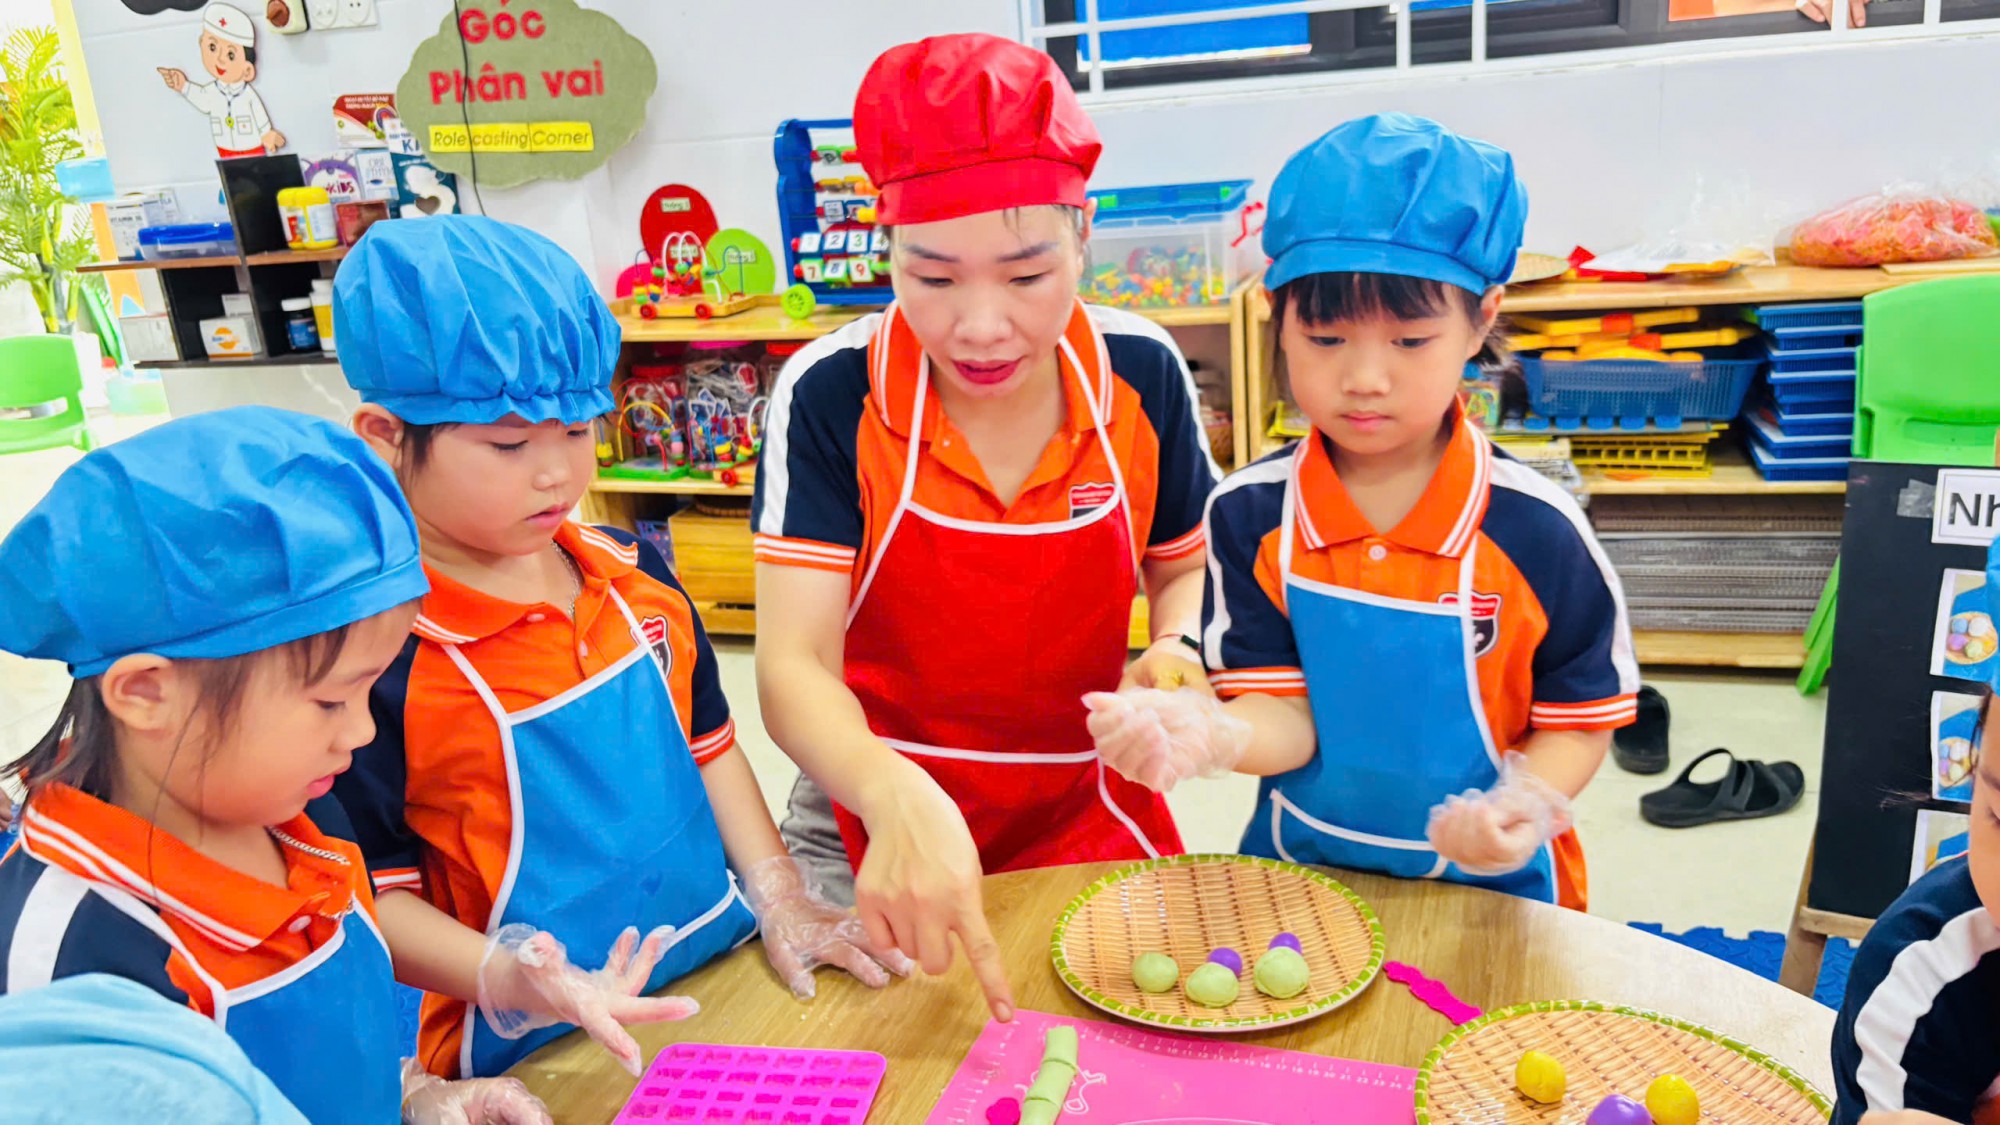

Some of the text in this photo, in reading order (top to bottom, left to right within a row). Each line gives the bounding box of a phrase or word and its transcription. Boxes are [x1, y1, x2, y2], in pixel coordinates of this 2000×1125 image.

[460, 0, 546, 44] Góc
[429, 59, 604, 105] Phân vai
[433, 129, 590, 149] Role casting Corner
[830, 234, 840, 246] 2
[853, 233, 863, 247] 3
[807, 263, 865, 280] 7 8 9
